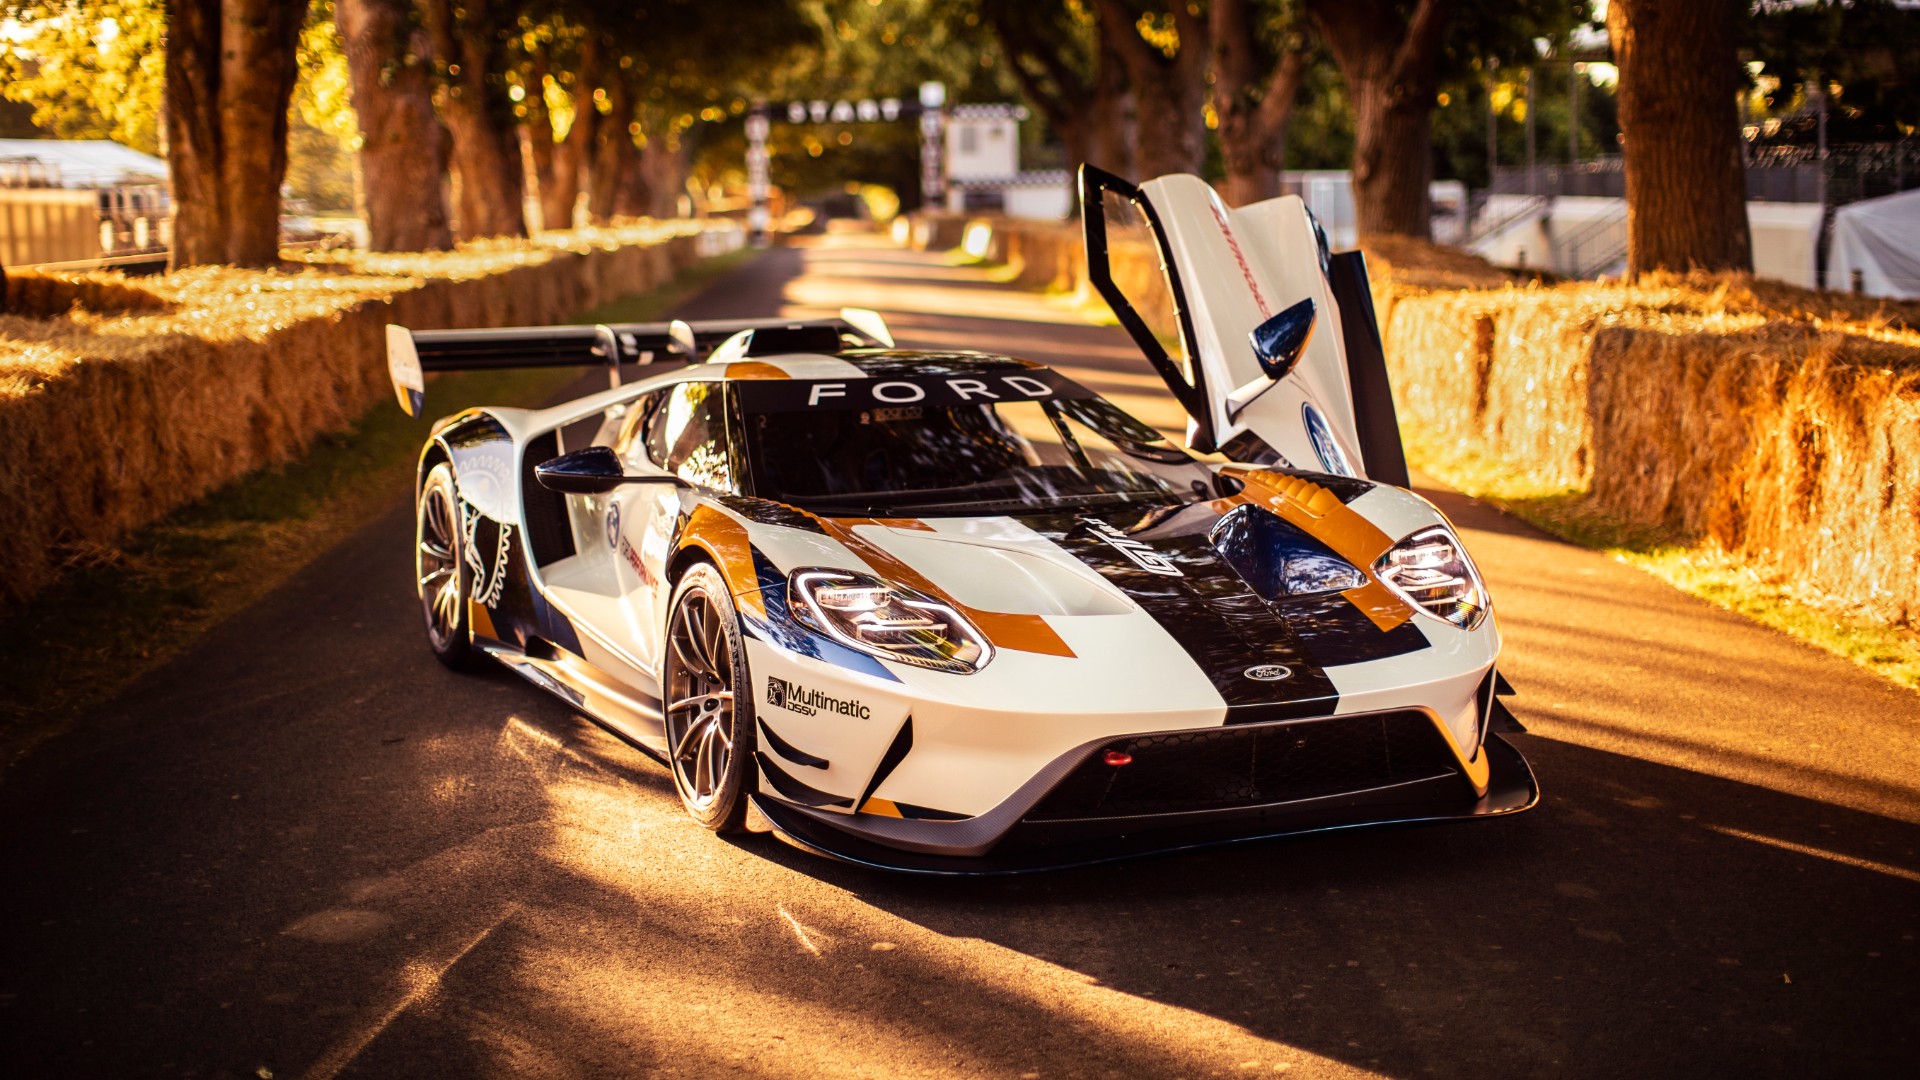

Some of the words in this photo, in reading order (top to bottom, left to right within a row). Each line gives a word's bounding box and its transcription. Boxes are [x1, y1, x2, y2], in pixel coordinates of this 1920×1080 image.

[787, 98, 902, 124] START
[808, 376, 1054, 405] FORD
[734, 667, 743, 725] MICHELIN
[788, 682, 870, 720] Multimatic
[788, 701, 817, 717] DSSV
